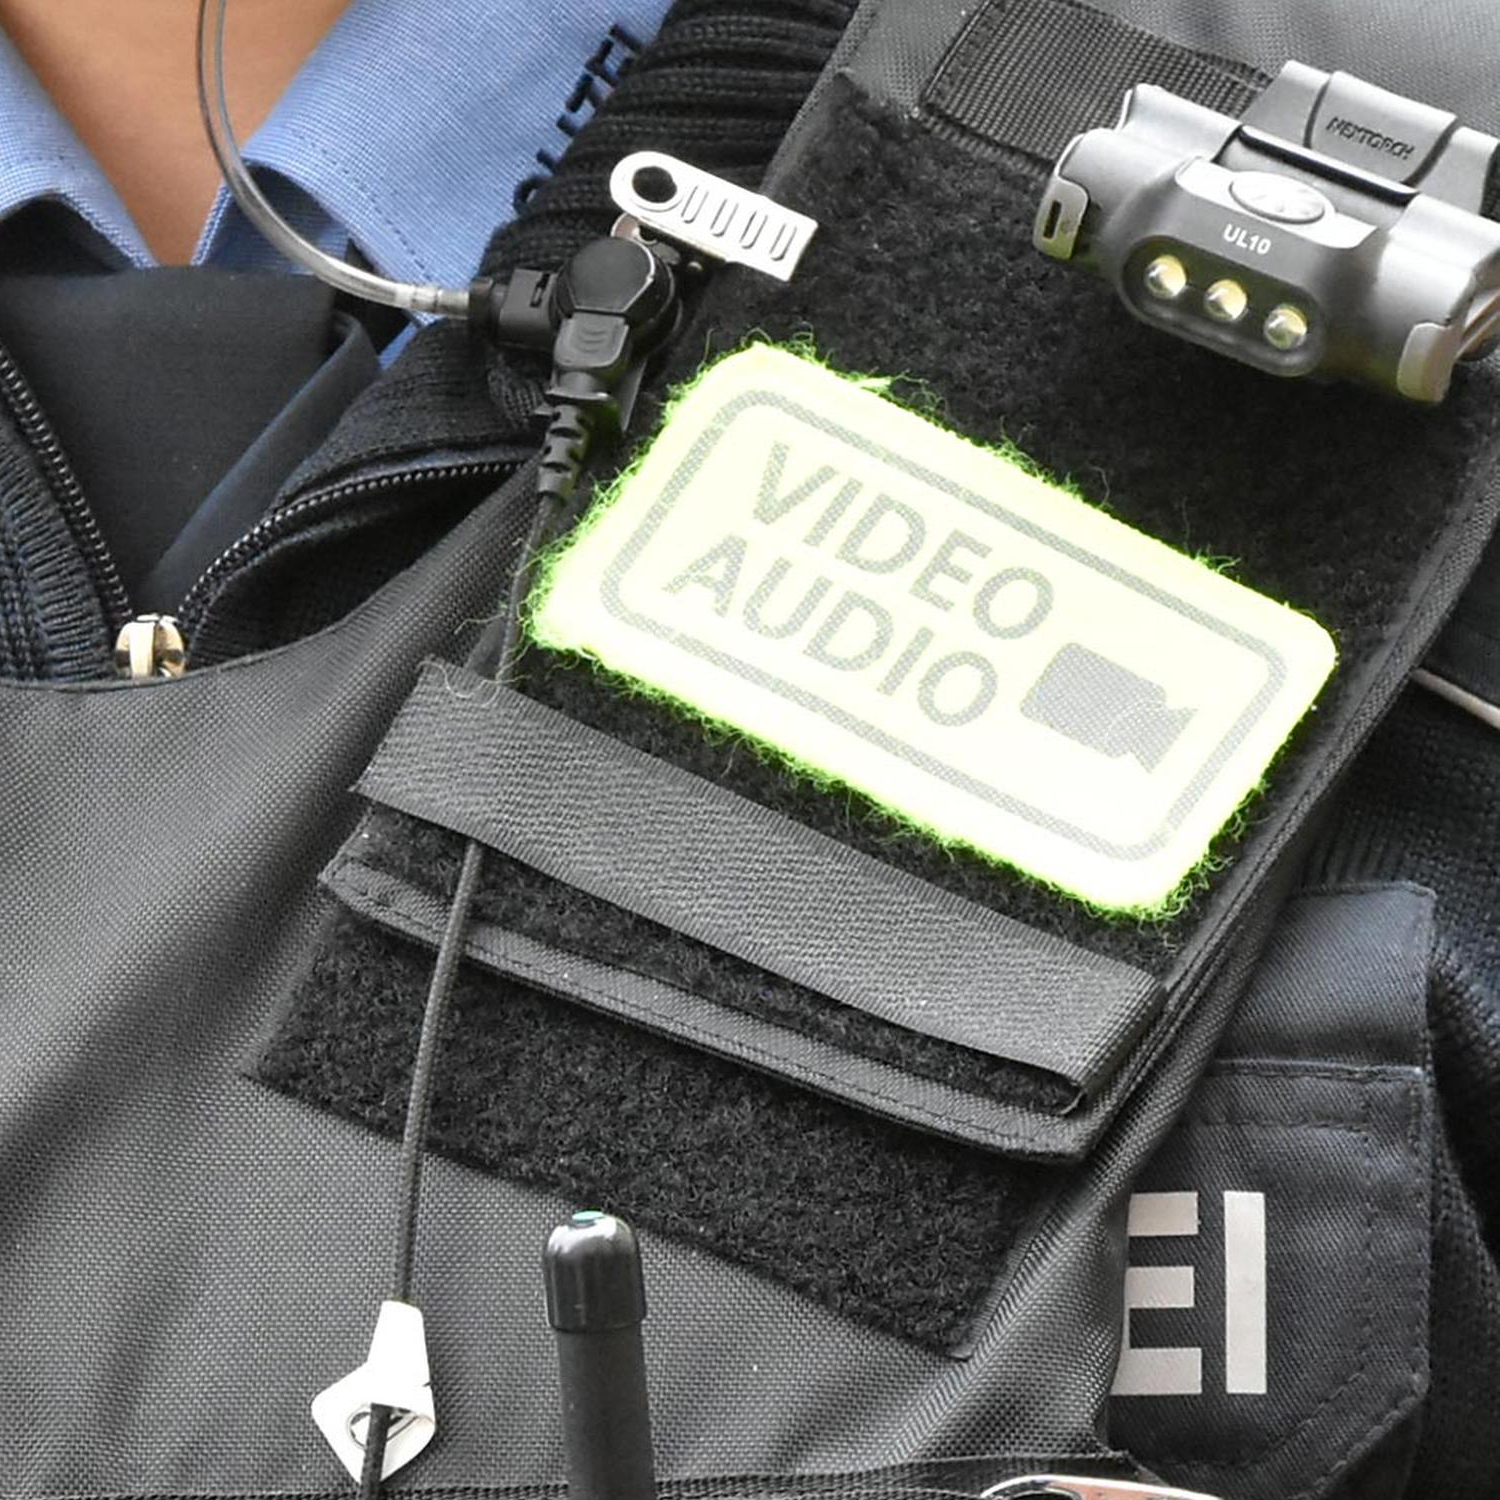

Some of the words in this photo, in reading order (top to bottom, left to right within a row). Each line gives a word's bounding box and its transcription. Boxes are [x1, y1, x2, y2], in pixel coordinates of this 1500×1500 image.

[1222, 223, 1272, 255] UL10
[661, 533, 999, 728] AUDIO
[752, 441, 1055, 640] VIDEO
